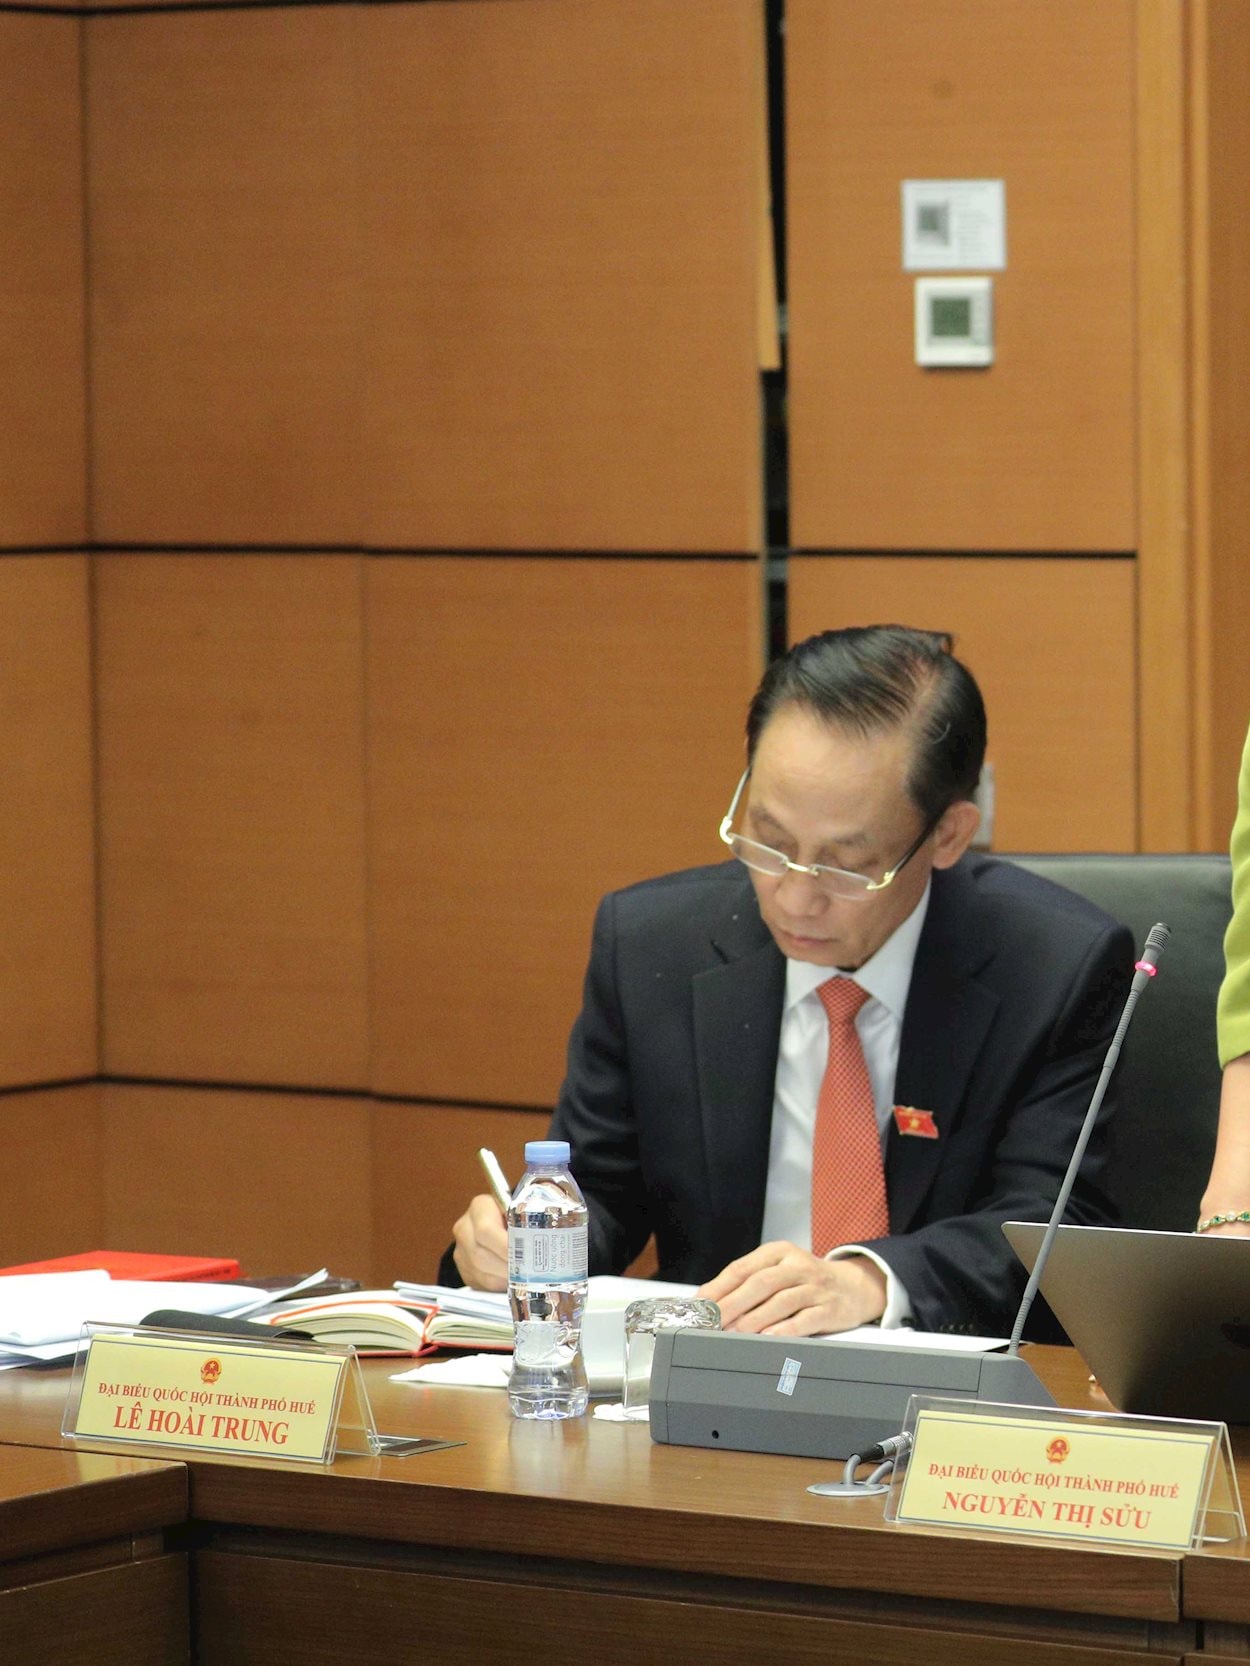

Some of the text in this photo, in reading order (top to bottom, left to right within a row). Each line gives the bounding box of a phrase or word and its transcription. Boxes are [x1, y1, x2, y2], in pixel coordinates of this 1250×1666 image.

[99, 1382, 316, 1415] ĐẠI BIỂU QUỐC HỘI THÀNH PHỐ HUẾ
[114, 1402, 288, 1445] LÊ HOÀI TRUNG
[928, 1463, 1179, 1499] ĐẠI BIỂU QUỐC HỘI THÀNH PHỐ HUẾ
[943, 1491, 1152, 1529] NGUYỄN THỊ SỬU
